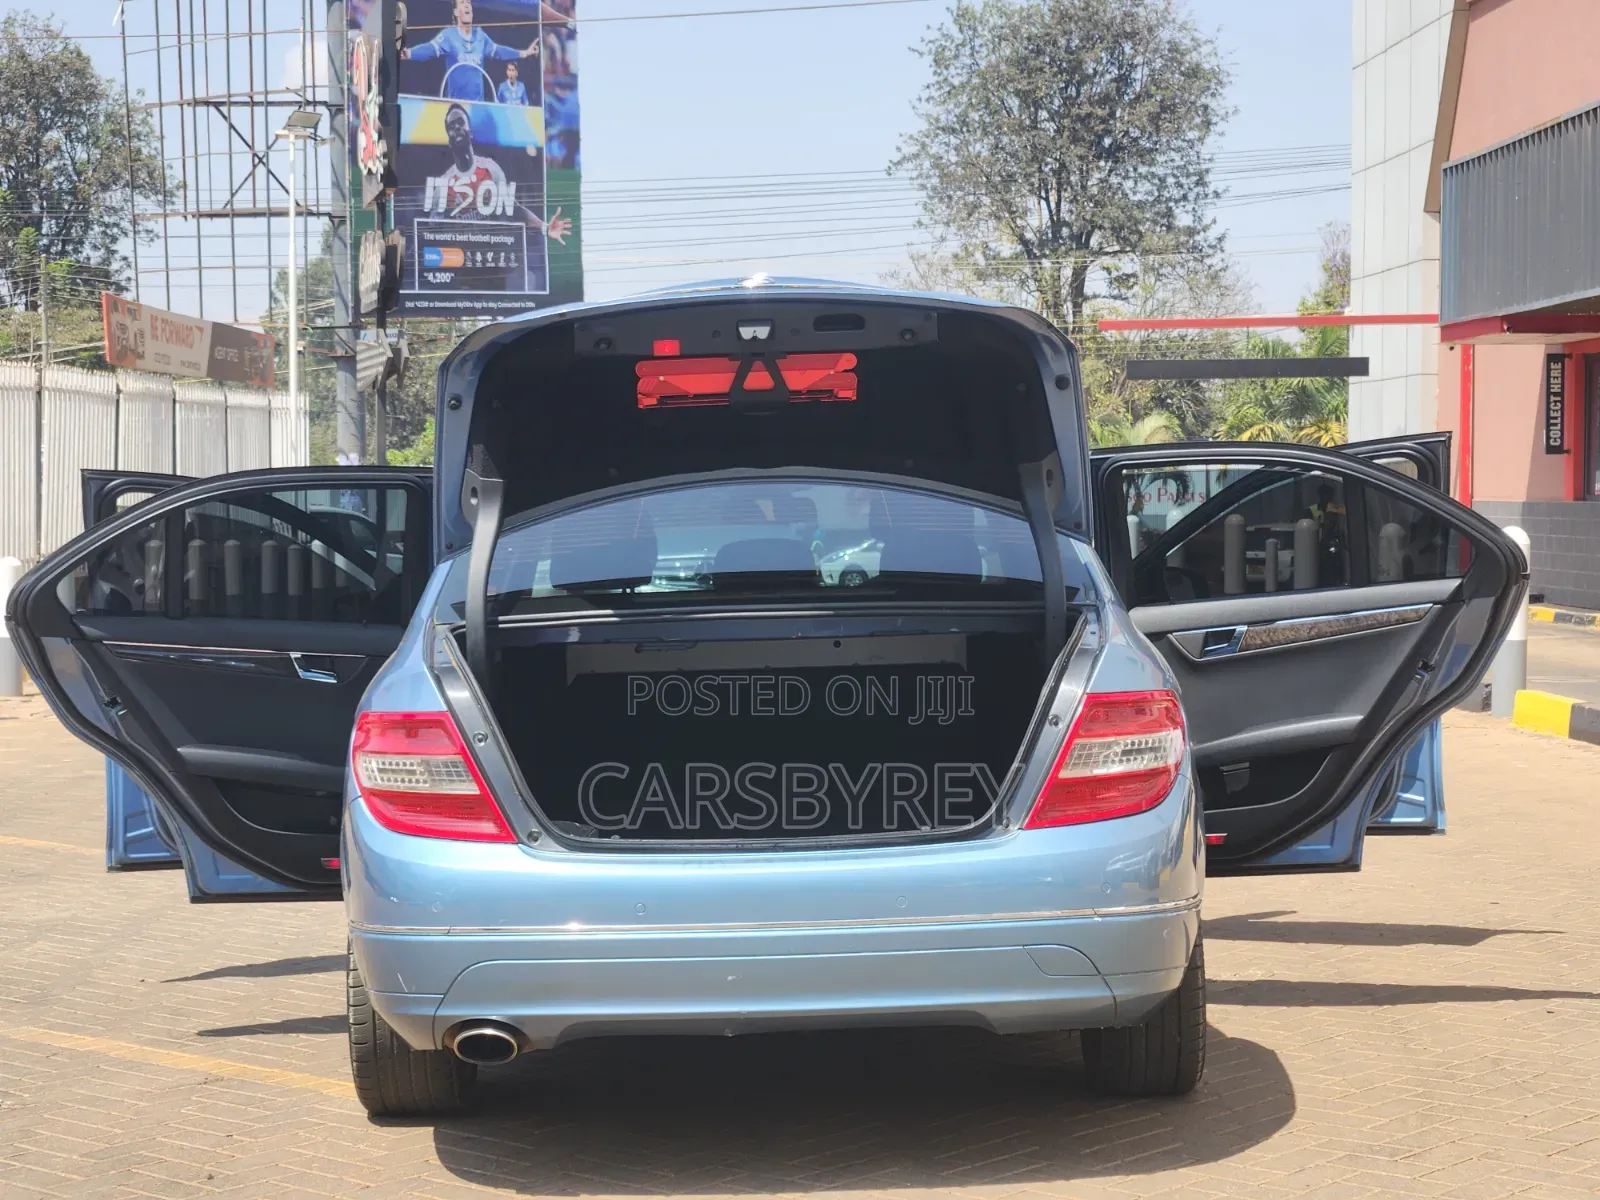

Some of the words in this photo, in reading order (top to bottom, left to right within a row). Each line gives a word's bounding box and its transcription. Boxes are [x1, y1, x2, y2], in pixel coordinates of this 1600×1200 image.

[476, 179, 517, 217] ON
[423, 232, 434, 240] The
[435, 233, 456, 241] world's
[456, 233, 469, 242] best
[469, 233, 491, 243] football
[490, 235, 515, 245] package
[149, 311, 159, 342] BE
[160, 317, 195, 350] FORWARD
[1550, 361, 1562, 393] HERE
[1549, 394, 1562, 447] COLLECT
